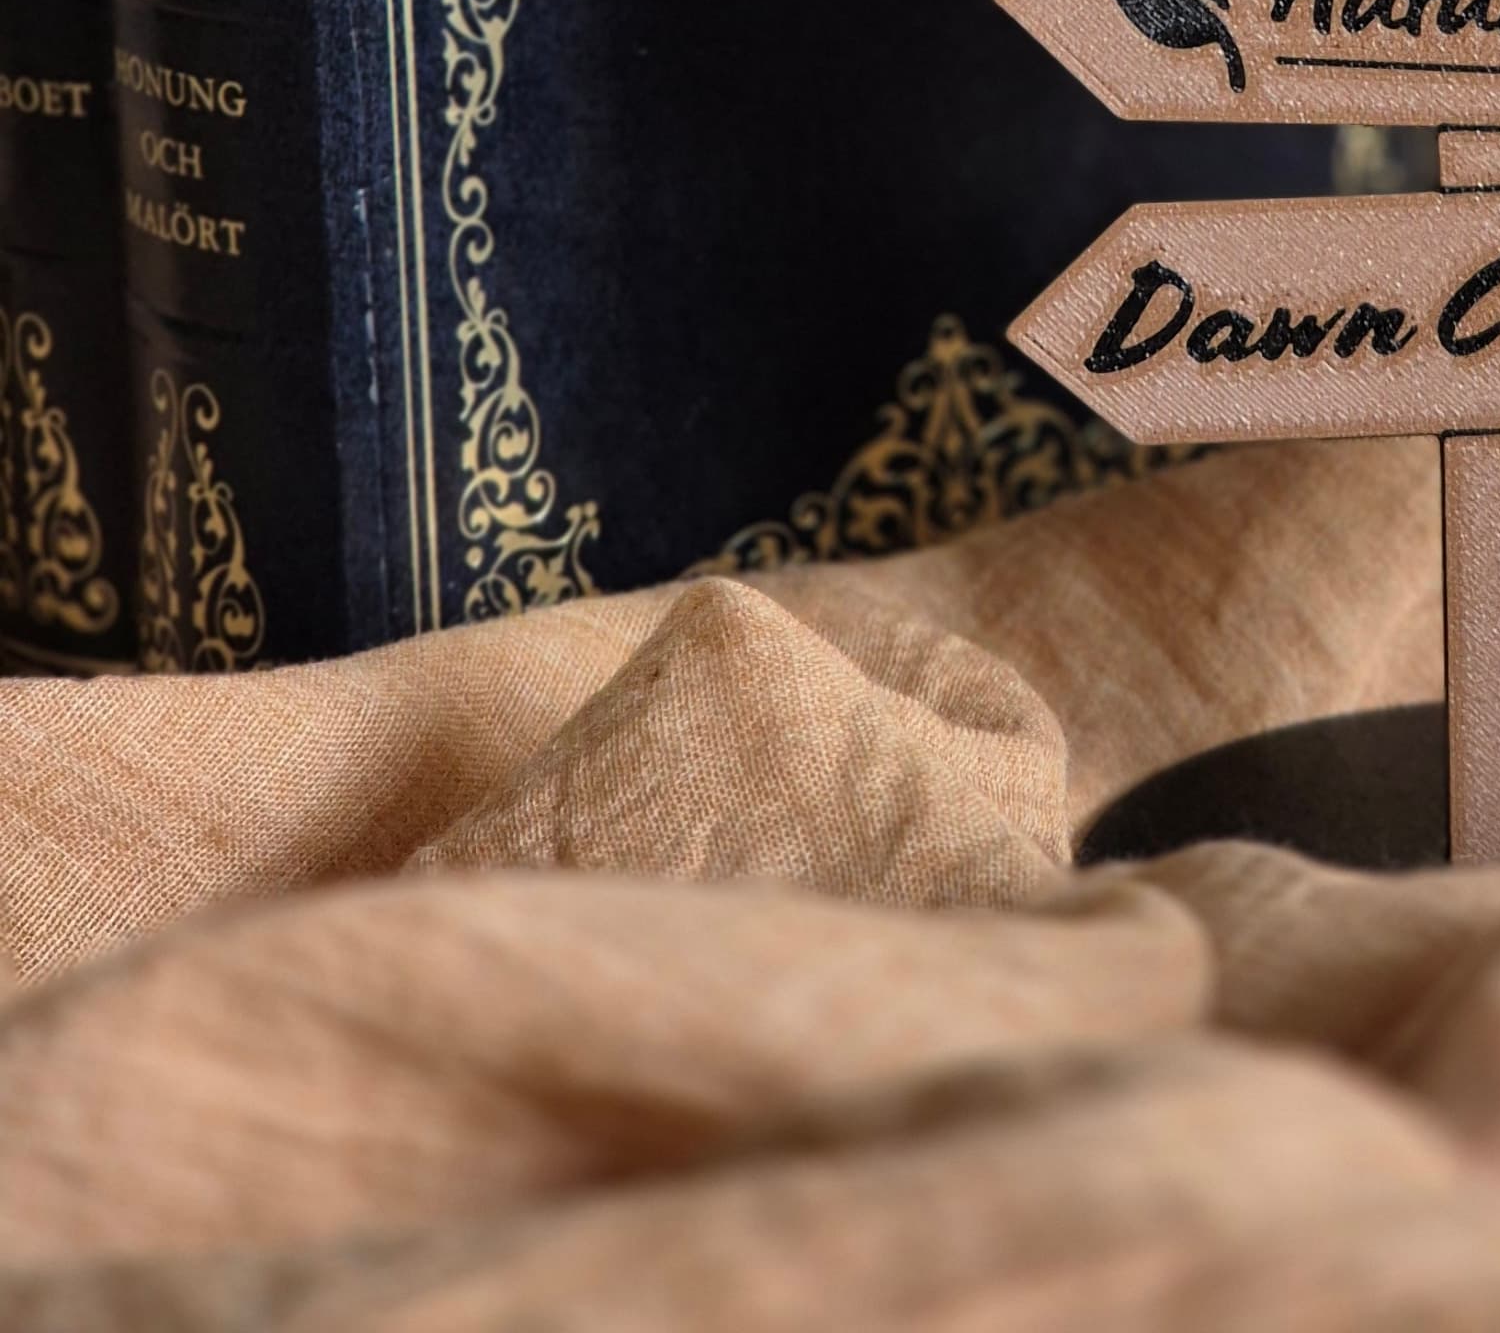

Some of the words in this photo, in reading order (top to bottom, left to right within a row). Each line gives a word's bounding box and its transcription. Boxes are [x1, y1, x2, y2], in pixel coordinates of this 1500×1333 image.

[140, 130, 205, 180] OCH
[125, 186, 246, 256] MALÖRT
[1083, 259, 1419, 375] Dawn
